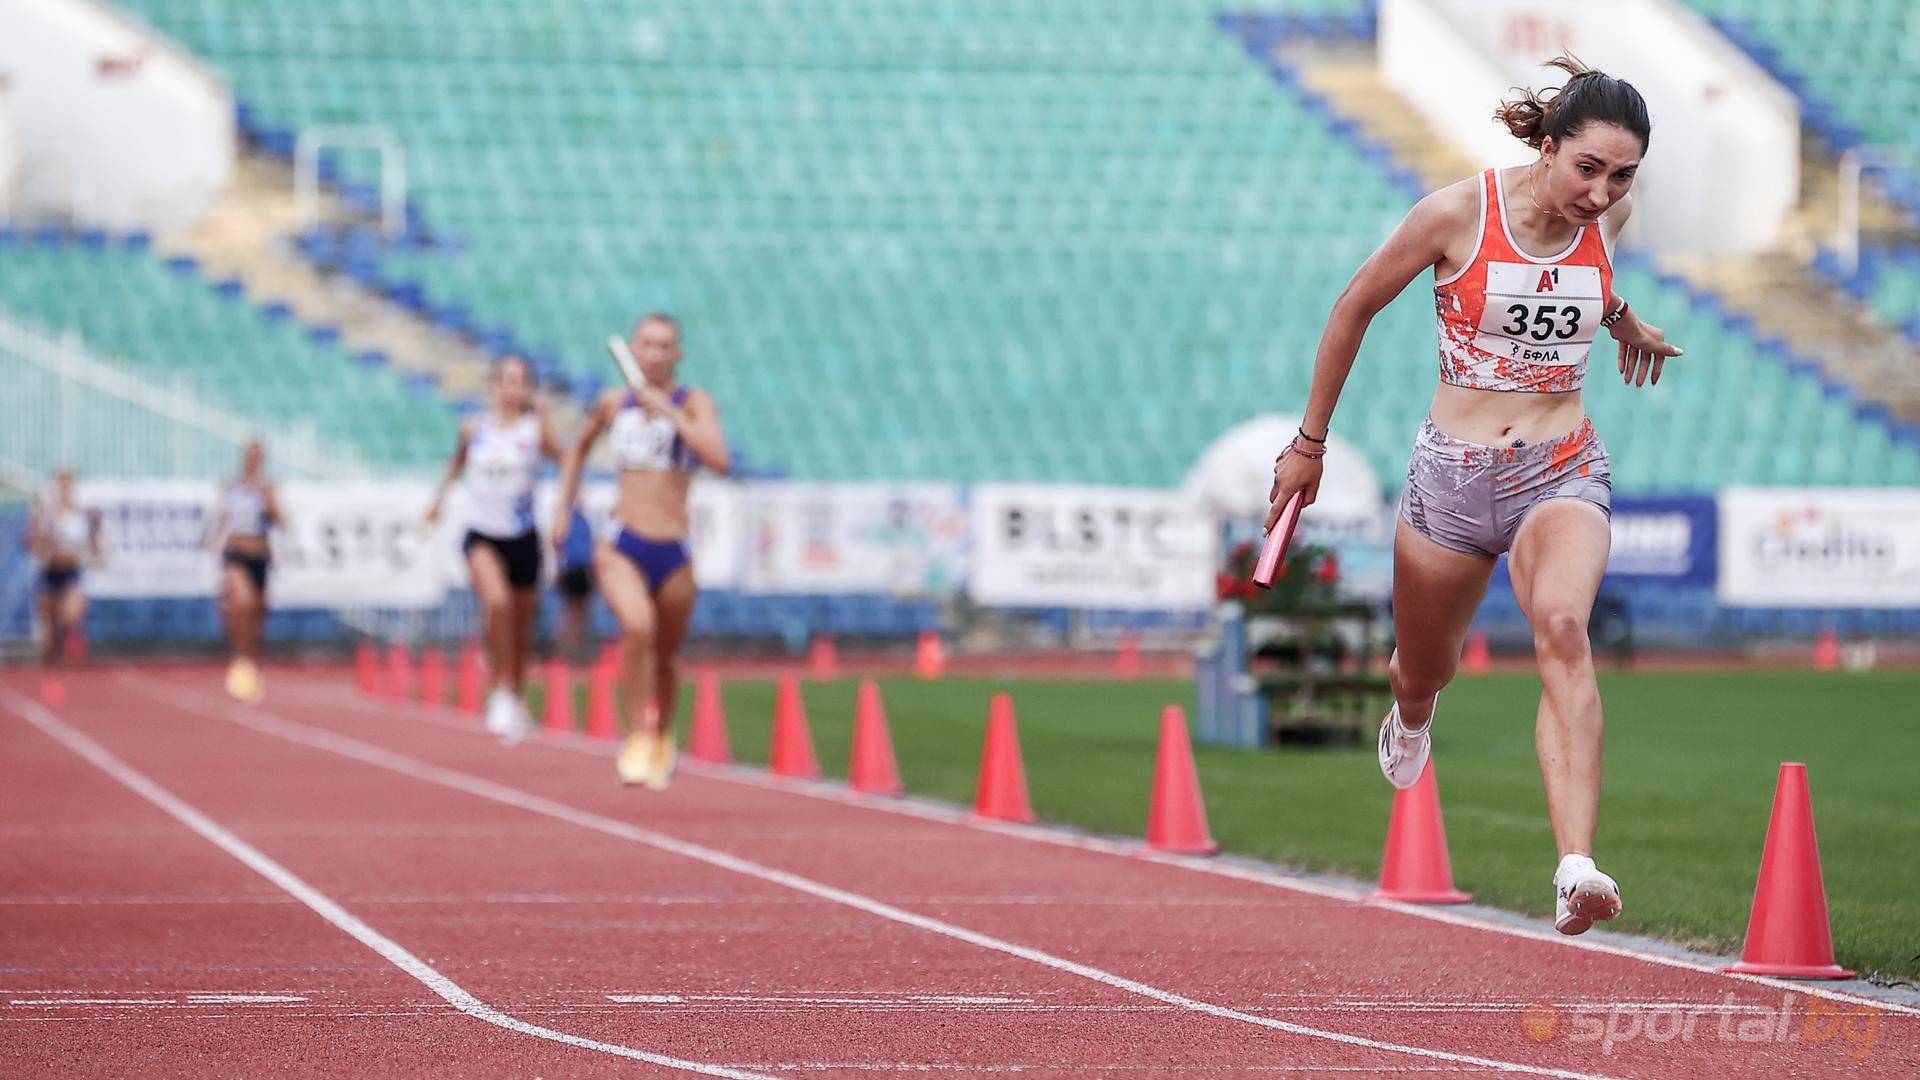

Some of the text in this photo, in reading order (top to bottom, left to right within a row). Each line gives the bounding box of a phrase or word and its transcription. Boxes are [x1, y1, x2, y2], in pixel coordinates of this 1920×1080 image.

[1536, 268, 1559, 293] A1
[1502, 304, 1581, 341] 353
[1523, 349, 1560, 362] БФЛА
